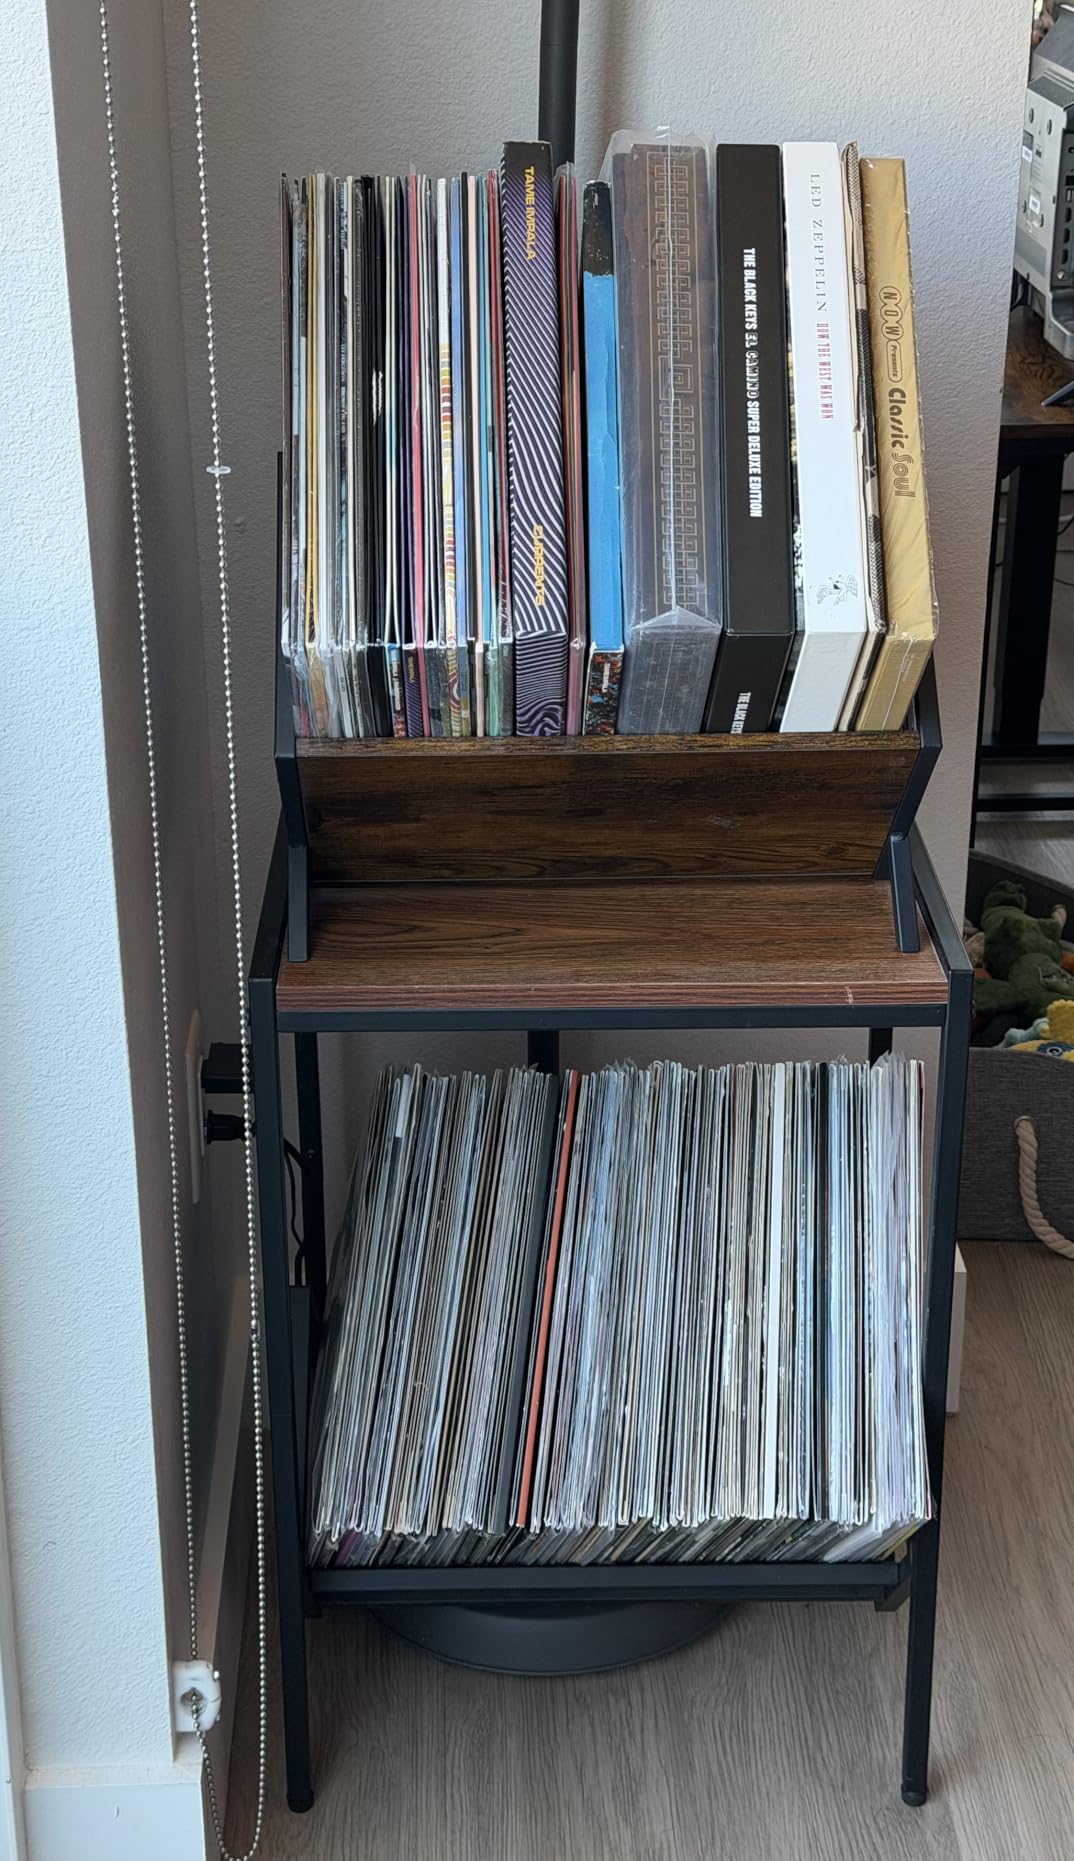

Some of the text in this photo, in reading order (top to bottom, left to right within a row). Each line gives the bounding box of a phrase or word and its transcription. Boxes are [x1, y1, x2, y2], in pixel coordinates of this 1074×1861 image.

[525, 166, 536, 260] TAME IMPALA
[810, 173, 827, 312] LED ZEPPELIN
[883, 291, 900, 335] NOW
[818, 343, 831, 358] THE
[819, 361, 832, 381] WEST
[891, 344, 900, 378] Presents
[743, 248, 763, 518] THE BLACK KEYS EL CAMINO SUPER DELUXE EDITION
[820, 384, 833, 400] WAS
[821, 402, 834, 419] WON
[888, 387, 916, 498] Classic Soul
[533, 525, 545, 606] CURRENTS
[730, 692, 752, 734] THE BLACK KEYS
